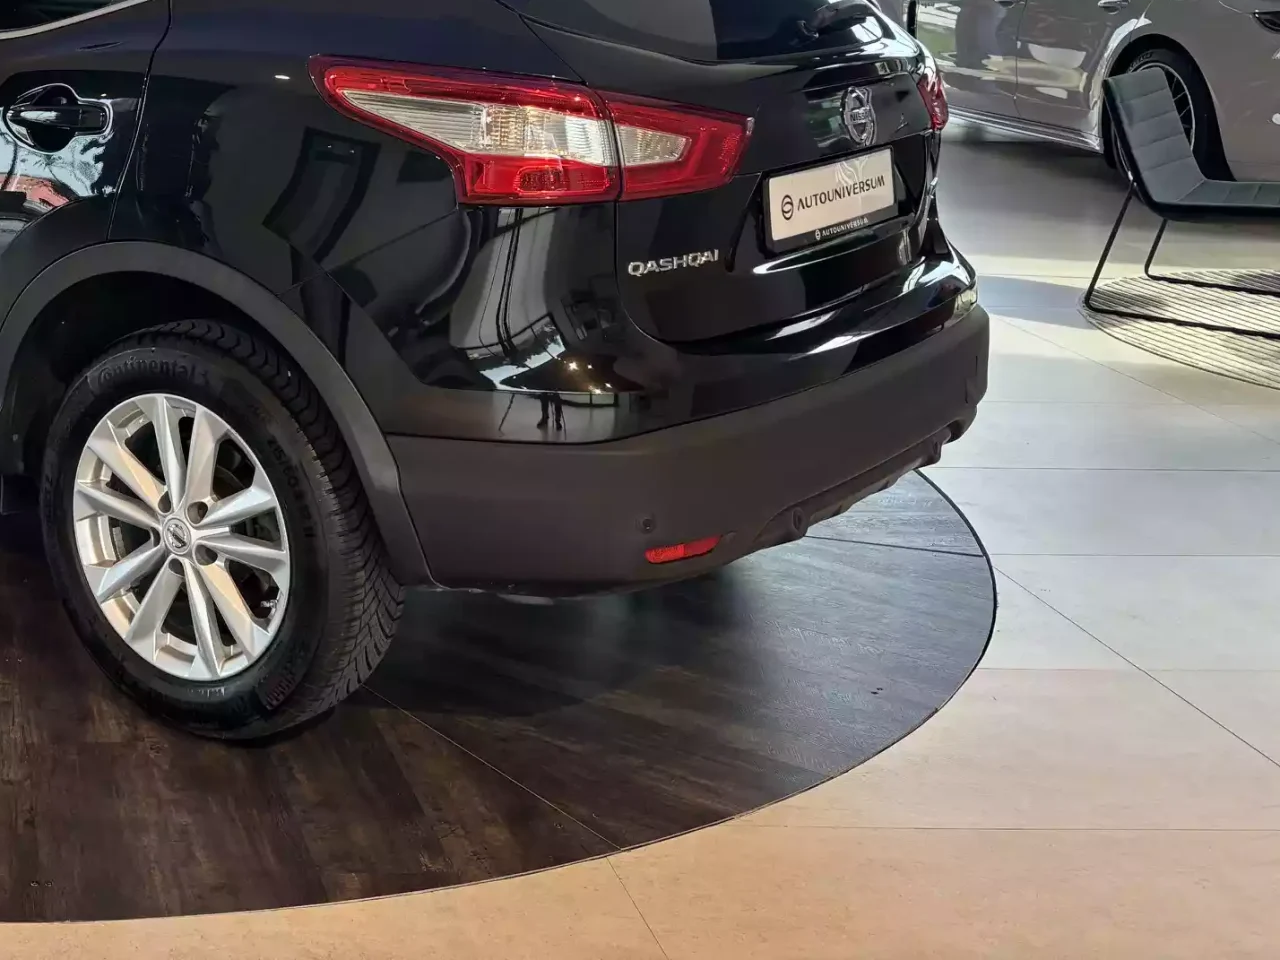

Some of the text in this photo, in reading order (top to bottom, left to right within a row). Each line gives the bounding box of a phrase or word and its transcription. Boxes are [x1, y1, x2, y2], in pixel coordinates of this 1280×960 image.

[797, 175, 885, 211] AUTOUNIVERSUM
[822, 217, 869, 237] AUTOUNIVERSUM
[628, 249, 719, 277] QASHQAI
